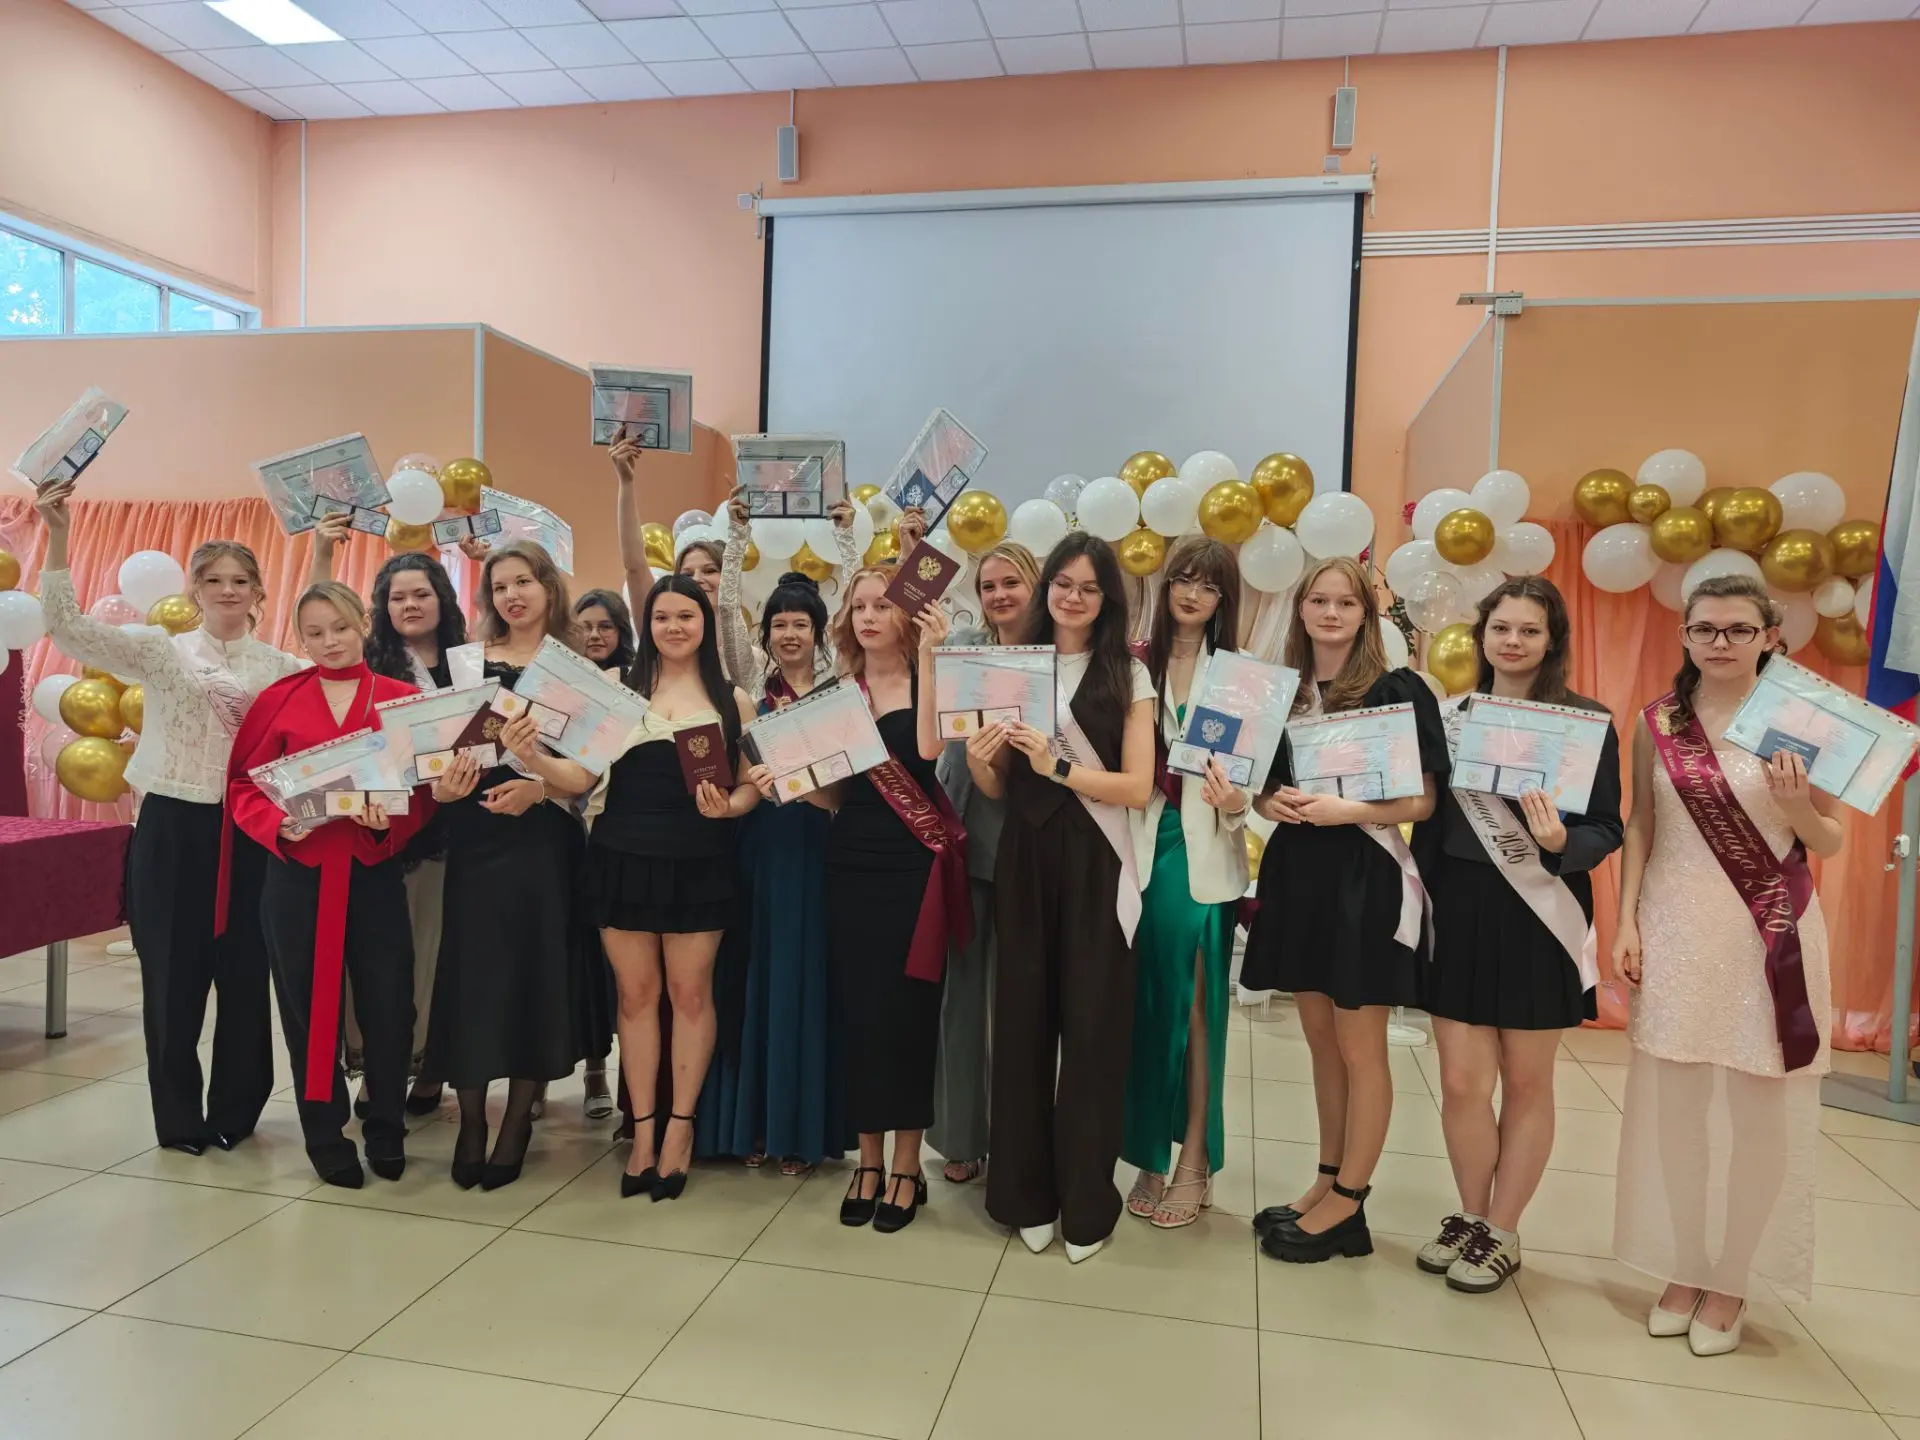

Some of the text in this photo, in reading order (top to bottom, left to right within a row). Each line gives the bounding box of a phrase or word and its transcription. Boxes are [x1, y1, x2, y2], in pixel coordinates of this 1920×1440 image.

[1491, 831, 1535, 865] 2026
[1672, 734, 1795, 934] Выпускница 2026
